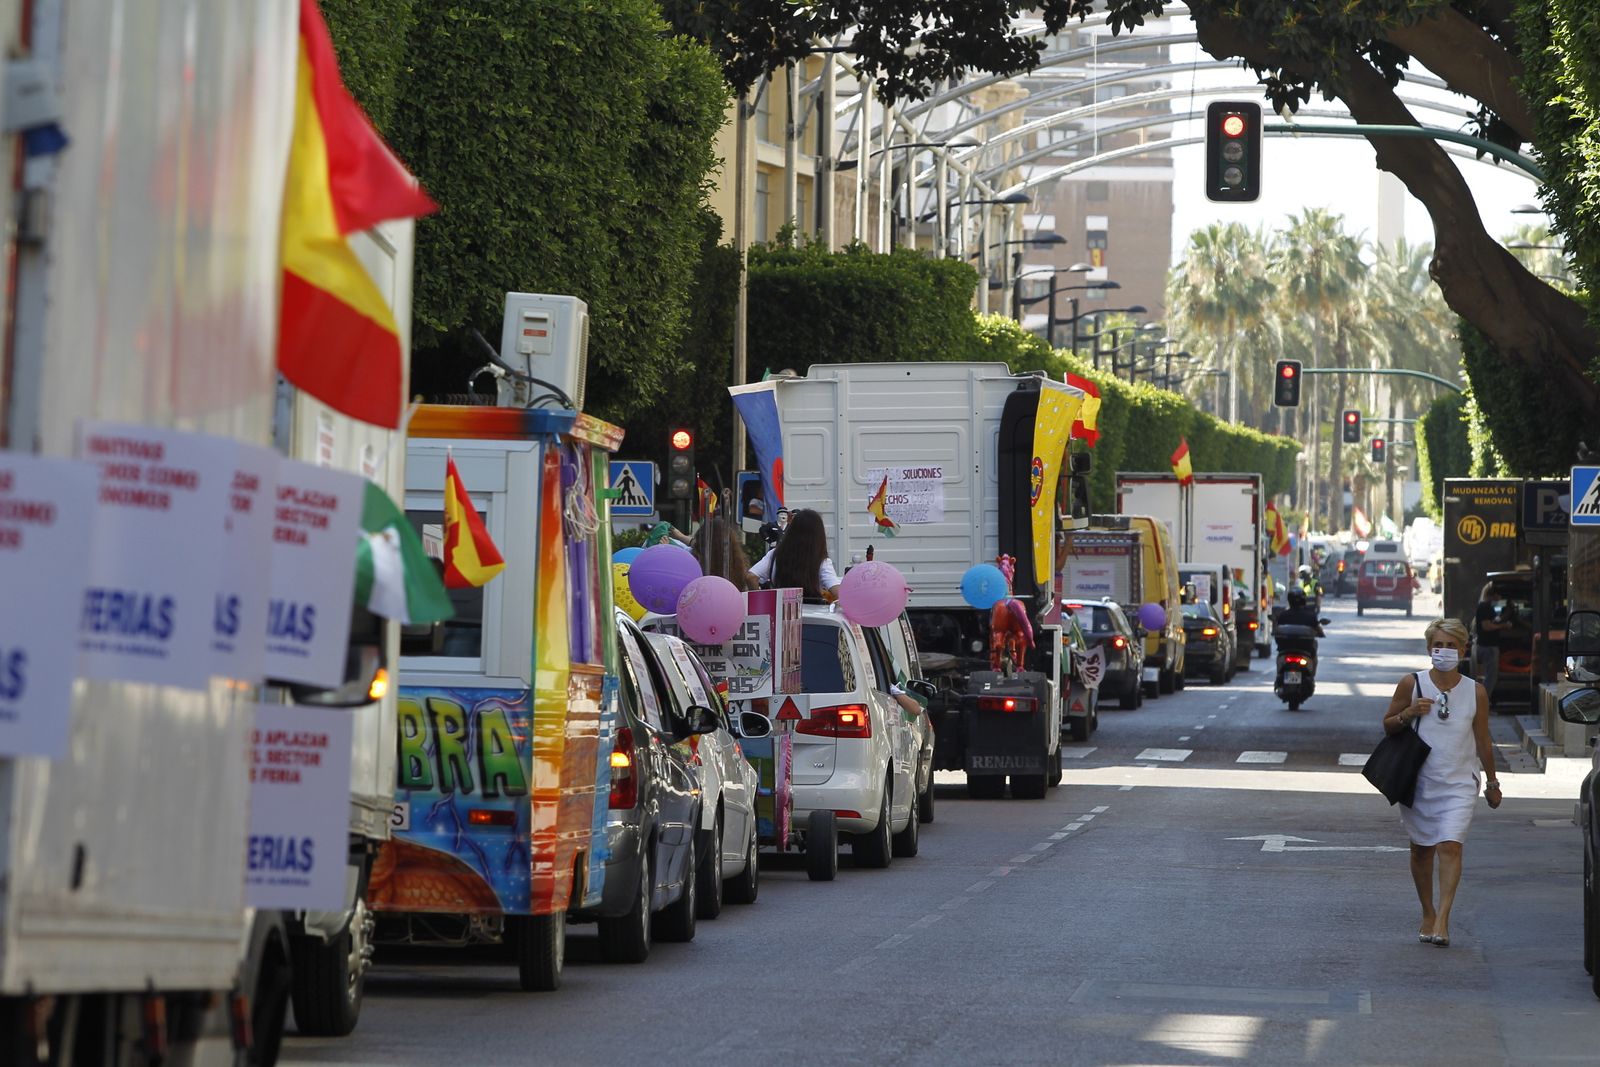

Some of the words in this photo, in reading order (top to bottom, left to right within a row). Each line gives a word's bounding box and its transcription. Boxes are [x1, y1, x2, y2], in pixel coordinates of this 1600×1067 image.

[902, 467, 942, 480] SOLUCIONES
[1452, 487, 1499, 495] MUDANZAS
[1507, 487, 1516, 495] G
[733, 643, 760, 657] CON
[264, 731, 329, 749] APLAZAR
[266, 751, 321, 767] SECTOR
[971, 756, 1041, 769] RENAULT
[260, 768, 302, 784] FERIA
